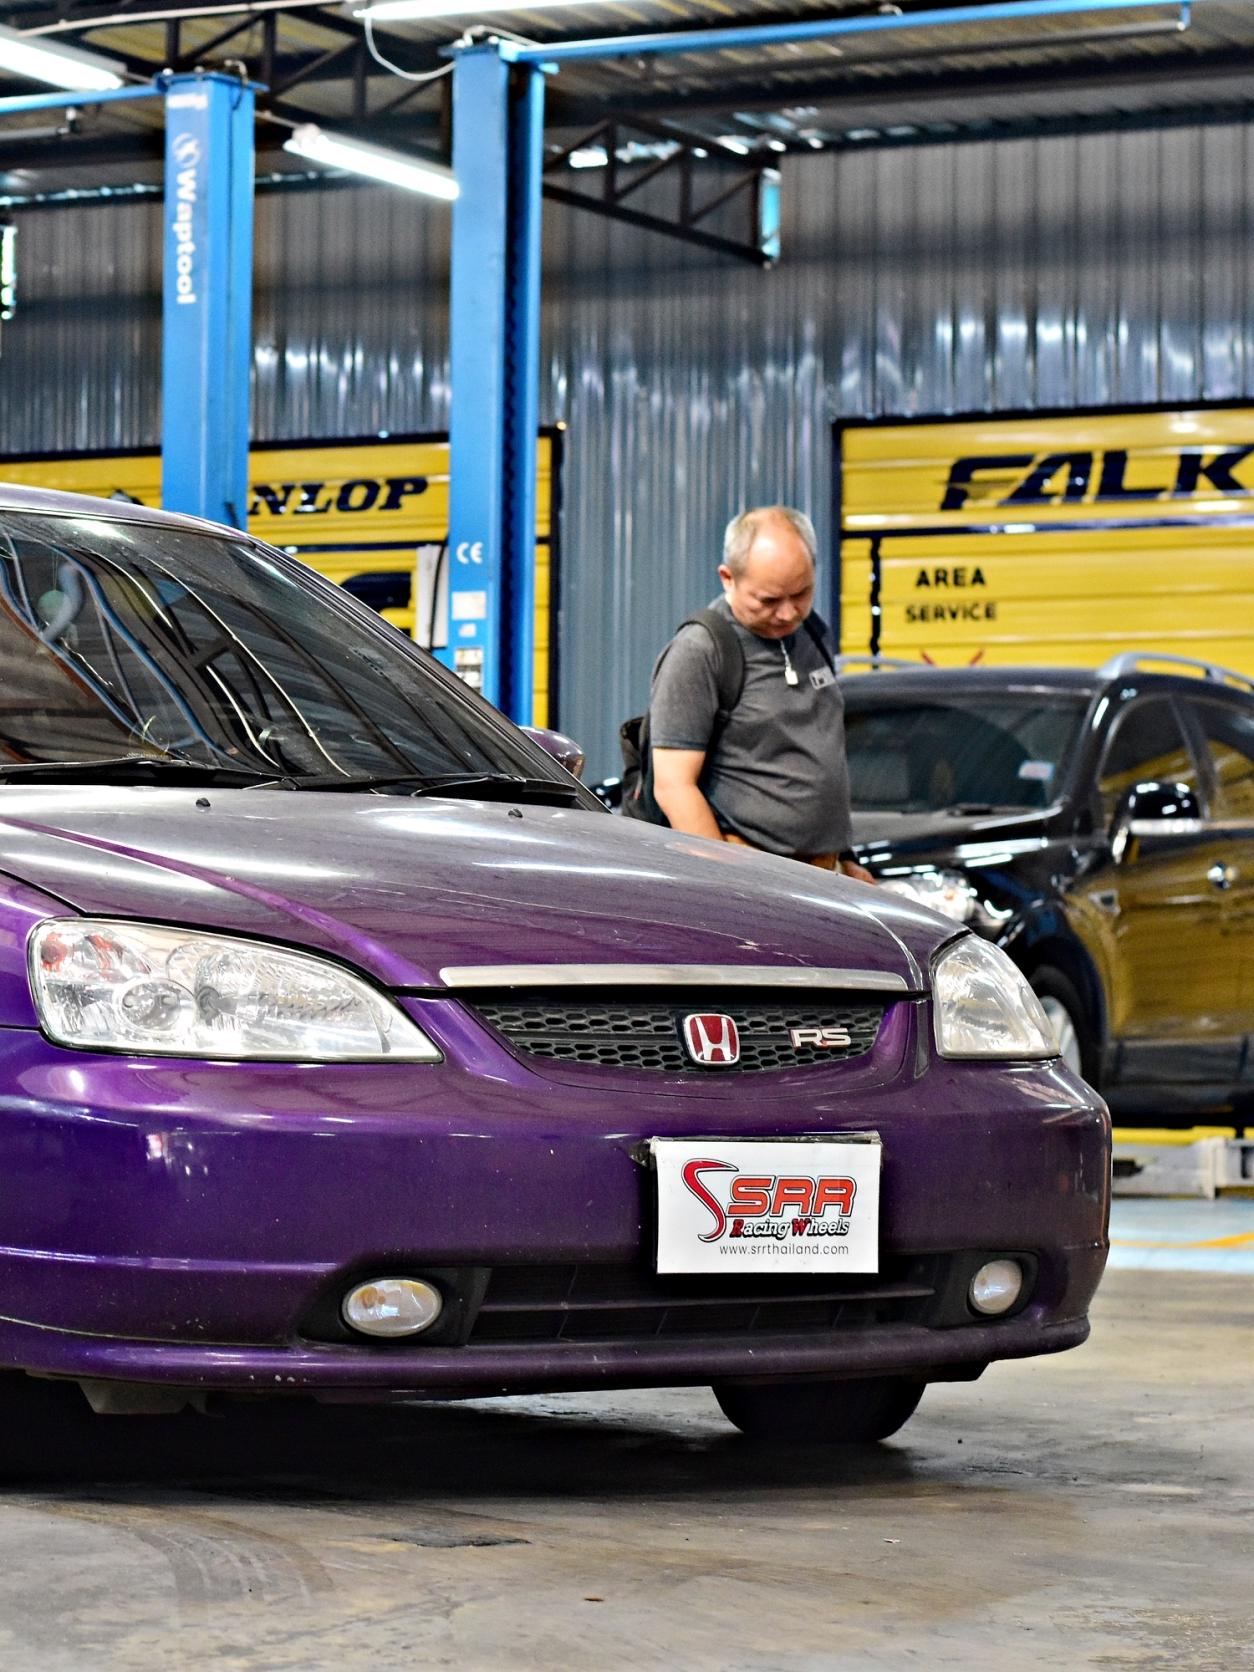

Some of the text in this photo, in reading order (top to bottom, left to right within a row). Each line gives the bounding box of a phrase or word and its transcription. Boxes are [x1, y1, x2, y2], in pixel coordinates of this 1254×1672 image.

[172, 167, 197, 304] Waptool
[940, 444, 1254, 511] FALK
[915, 566, 986, 588] AREA
[906, 602, 997, 623] SERVICE
[791, 1027, 852, 1049] RS
[729, 1218, 851, 1240] Racing Wheels
[719, 1243, 849, 1255] www.srrthailand.com
